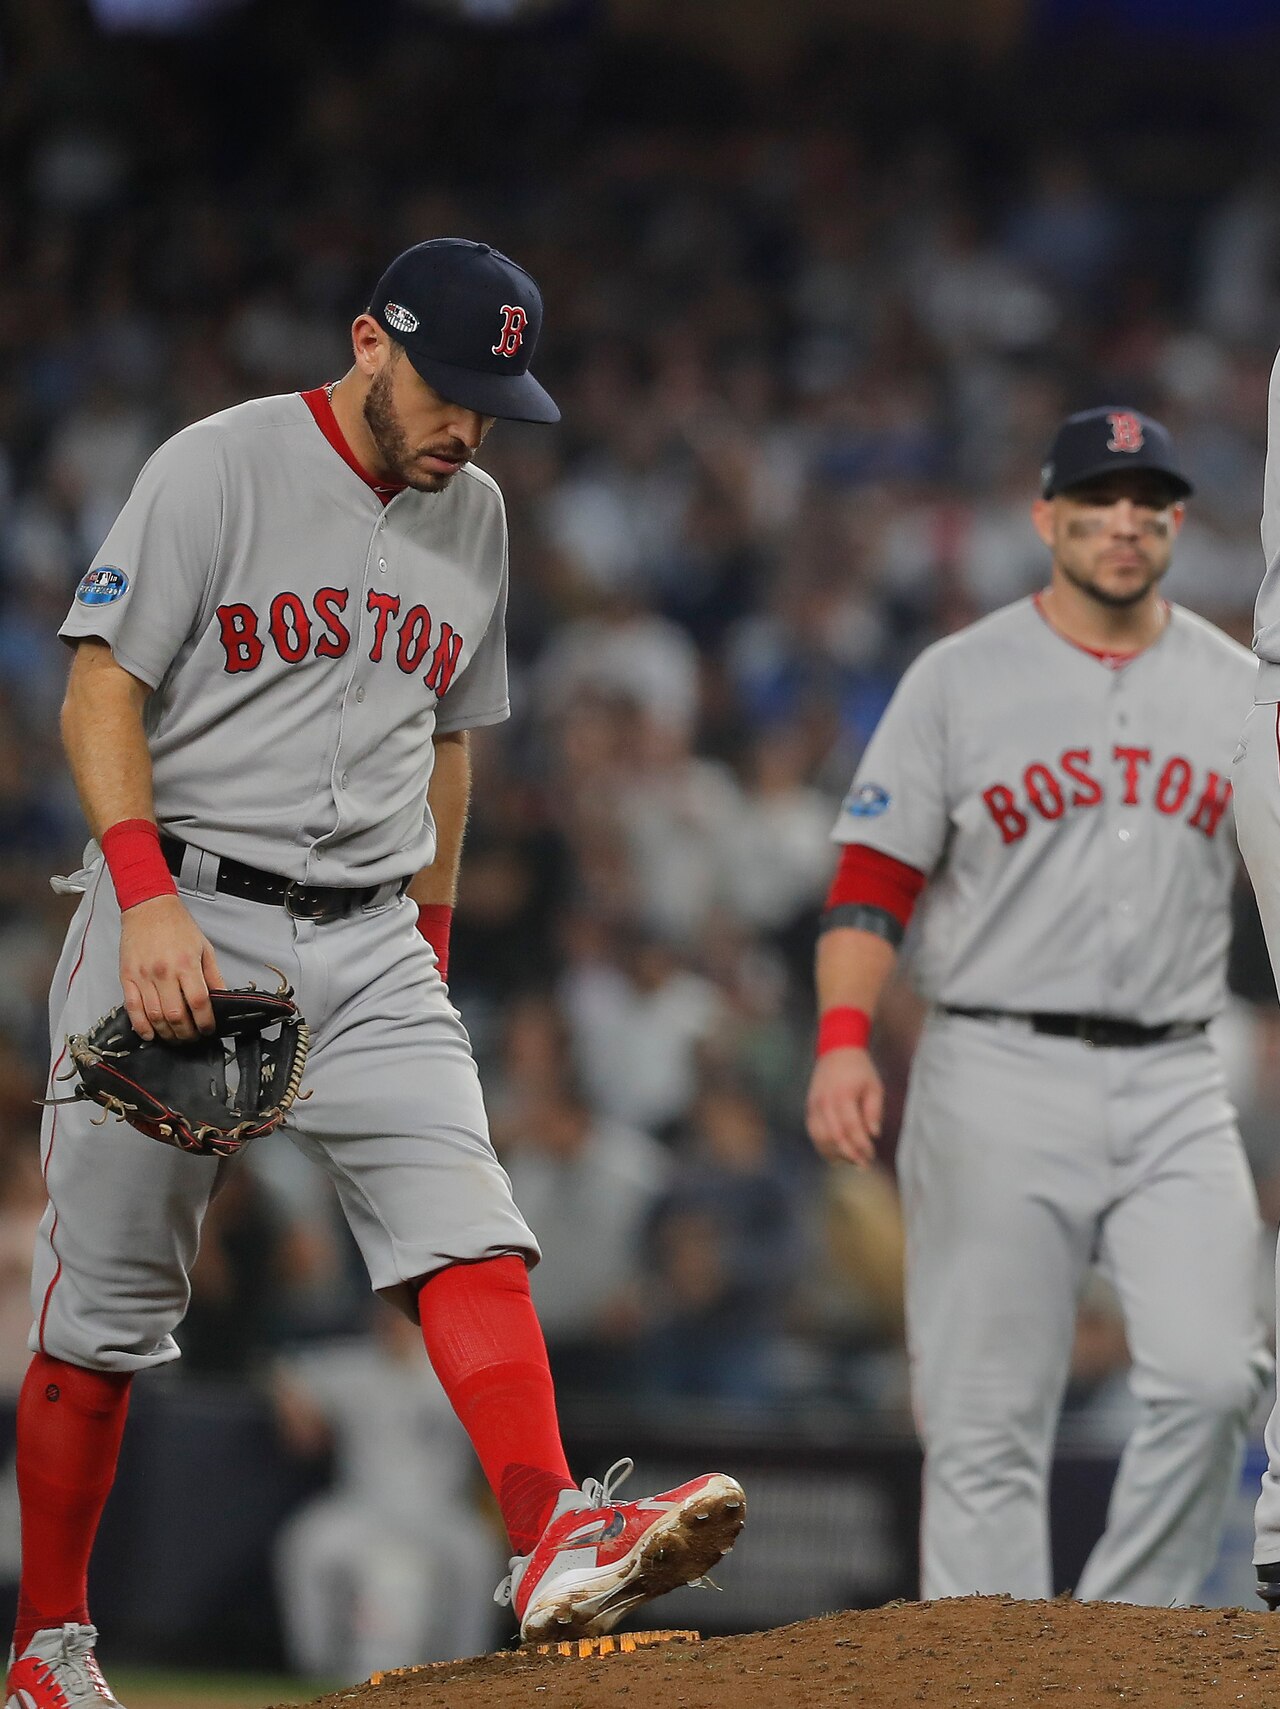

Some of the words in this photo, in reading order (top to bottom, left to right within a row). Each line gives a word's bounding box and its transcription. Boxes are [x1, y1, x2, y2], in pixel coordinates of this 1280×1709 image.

[491, 304, 528, 358] B
[1106, 412, 1145, 454] B
[217, 587, 464, 698] BOSTON
[982, 746, 1233, 845] BOSTON
